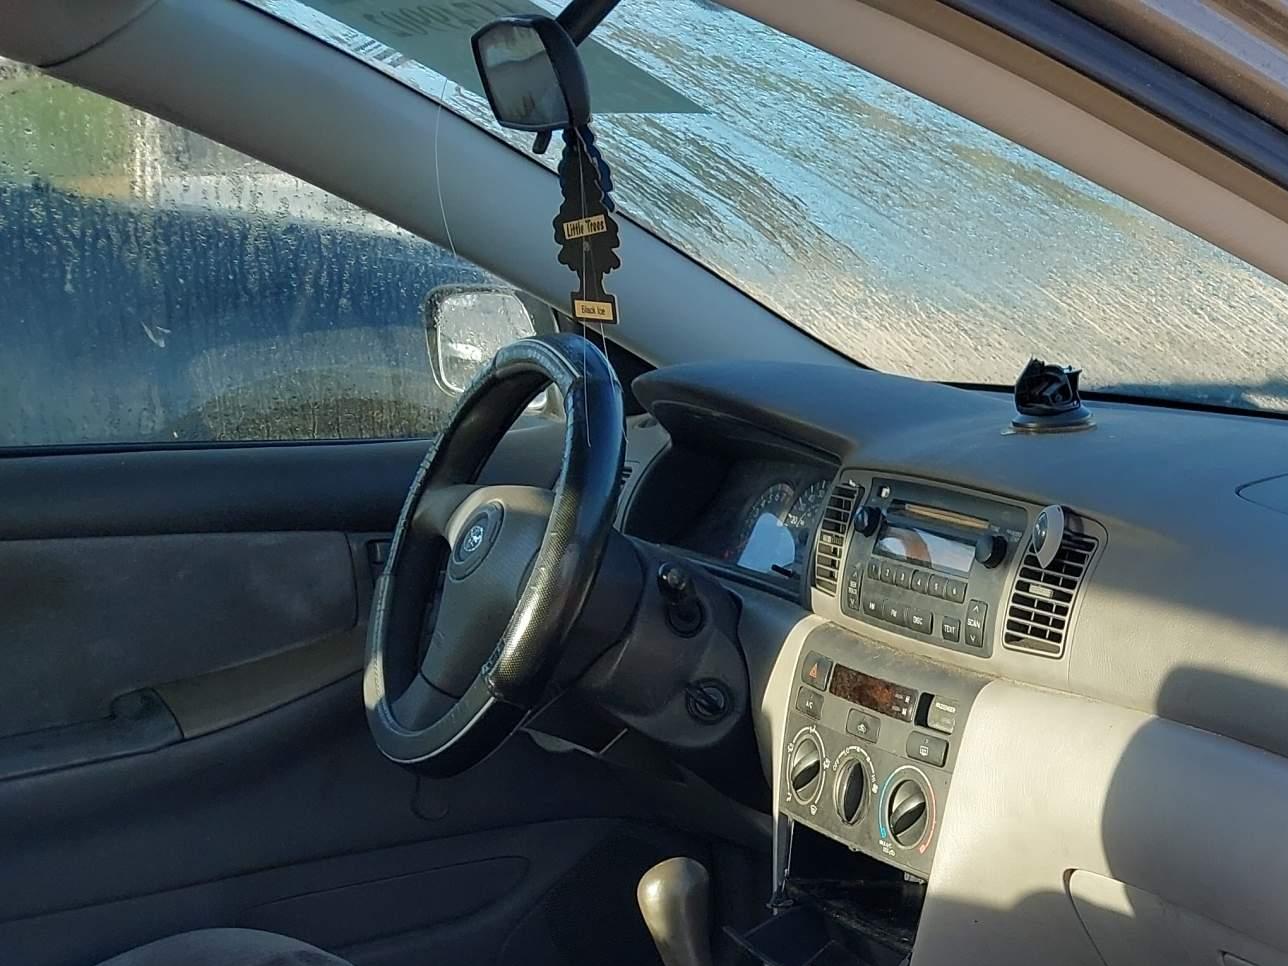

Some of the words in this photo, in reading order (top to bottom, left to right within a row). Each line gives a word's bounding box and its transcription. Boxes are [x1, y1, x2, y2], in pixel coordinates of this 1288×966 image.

[566, 223, 584, 238] Little
[585, 219, 604, 233] Trees
[943, 624, 957, 634] TEXT
